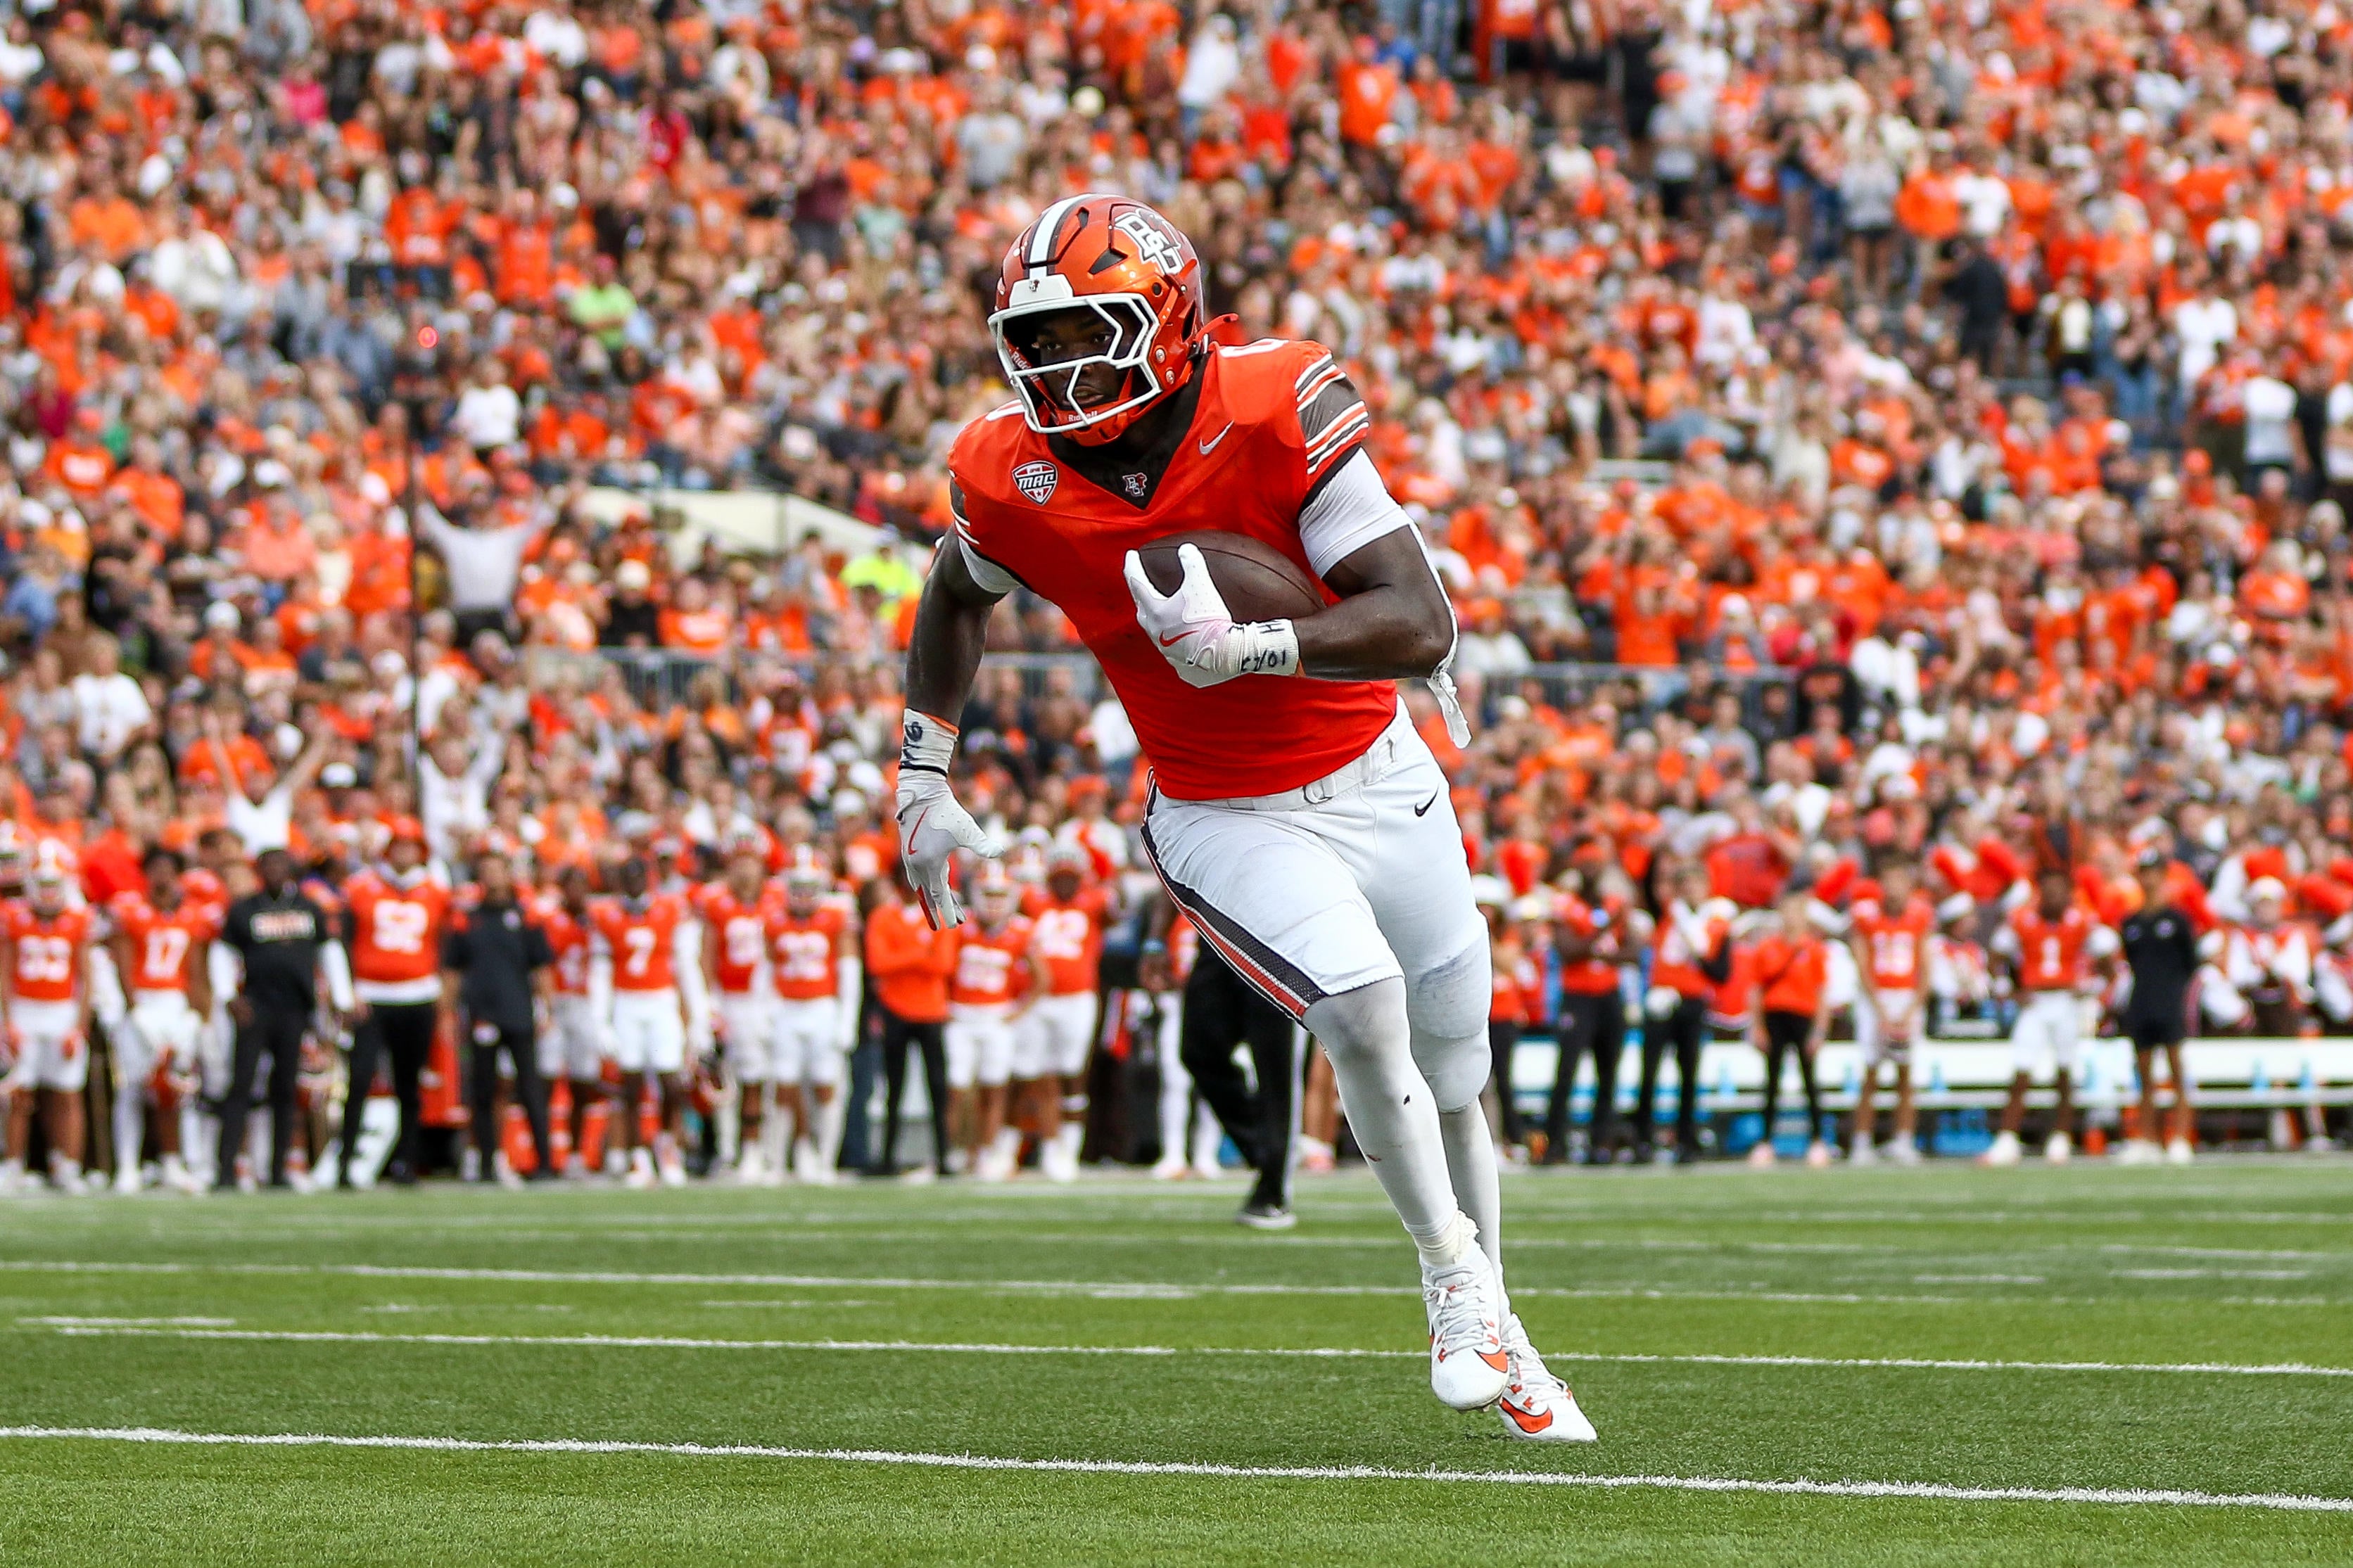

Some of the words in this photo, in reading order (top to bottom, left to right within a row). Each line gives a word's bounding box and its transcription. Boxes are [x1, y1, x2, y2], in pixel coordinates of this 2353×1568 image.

[1019, 473, 1055, 490] MAC
[623, 926, 656, 977] 7
[2041, 936, 2061, 978] 1
